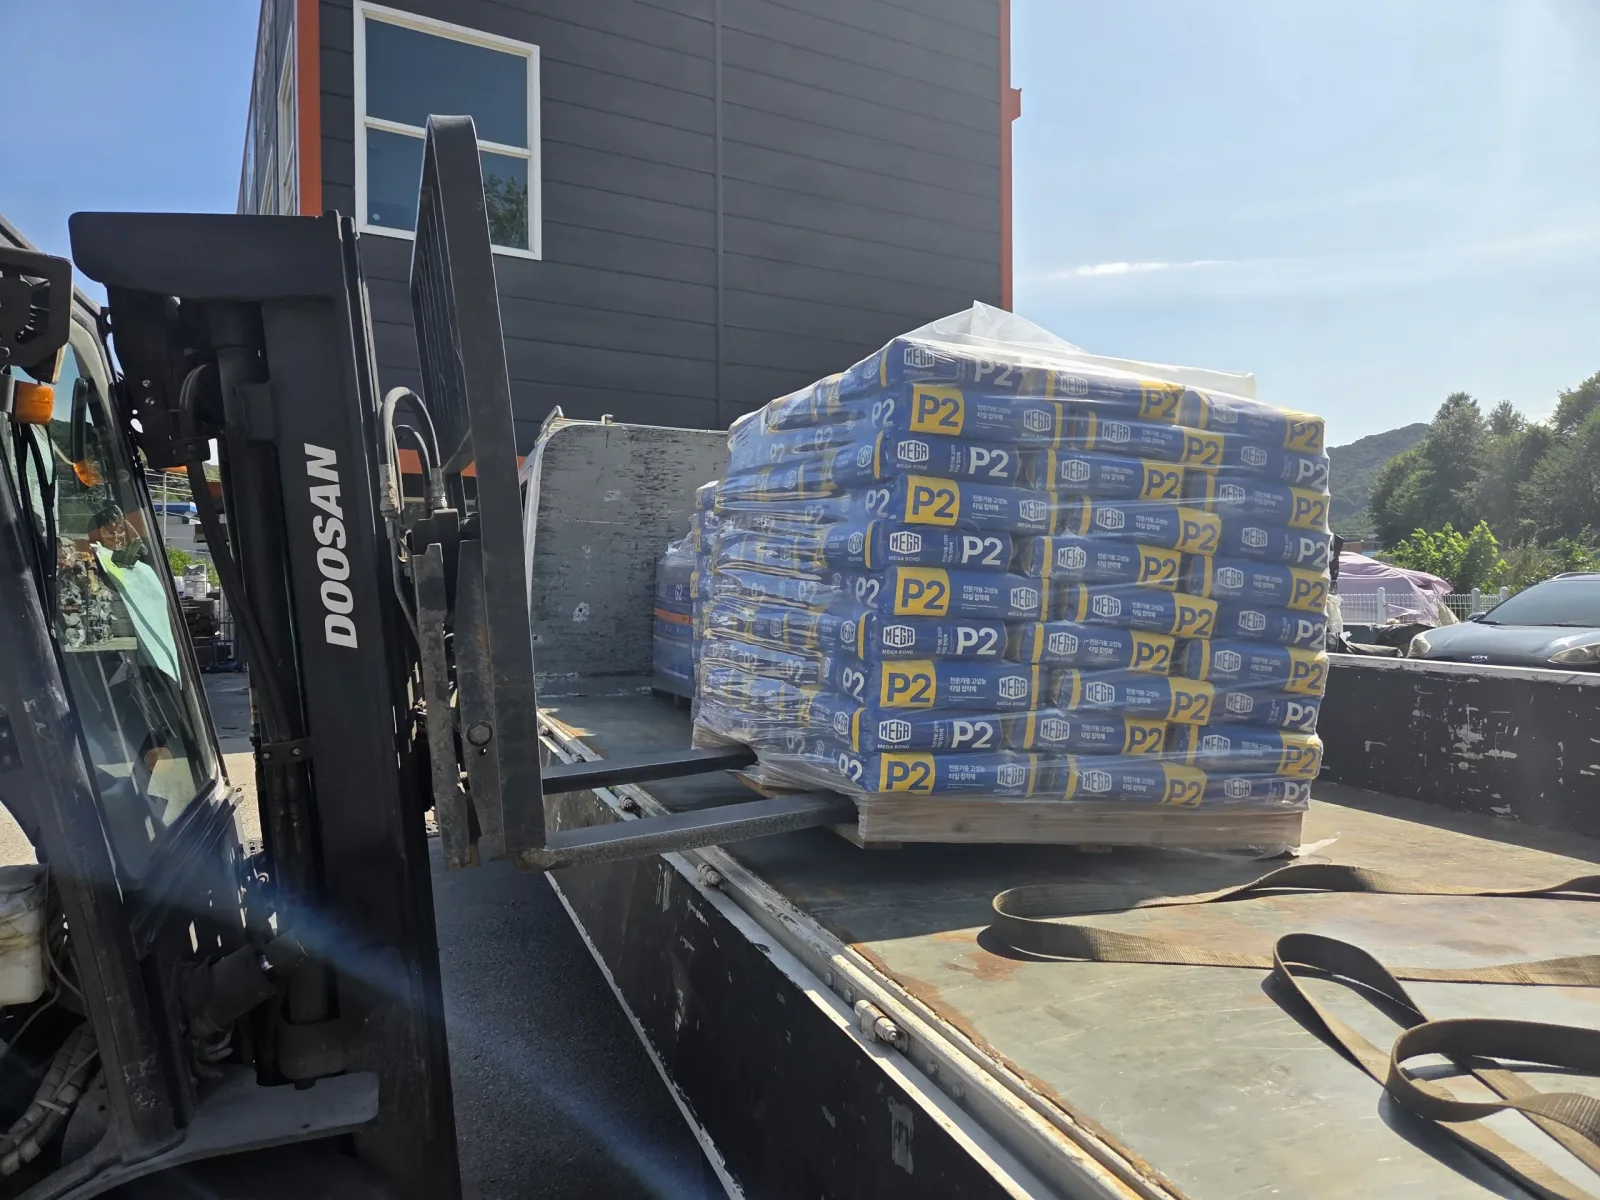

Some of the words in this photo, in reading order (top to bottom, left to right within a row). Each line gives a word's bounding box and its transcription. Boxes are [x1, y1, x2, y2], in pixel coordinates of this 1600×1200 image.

[905, 349, 934, 367] MEGA
[974, 359, 1013, 387] P2
[1061, 376, 1087, 394] MEGA
[917, 394, 960, 427] P2
[1144, 390, 1178, 418] P2
[1024, 410, 1050, 431] MEGA
[1103, 422, 1129, 442] MEGA
[1289, 421, 1319, 448] P2
[898, 441, 928, 462] MEGA
[968, 447, 1009, 477] P2
[1184, 436, 1218, 465] P2
[1063, 460, 1089, 481] MEGA
[1296, 459, 1328, 489] P2
[1145, 470, 1179, 499] P2
[1221, 485, 1244, 504] MEGA
[866, 489, 890, 517] P2
[912, 486, 955, 518] P2
[1020, 500, 1046, 520] MEGA
[1295, 497, 1324, 526] P2
[1097, 508, 1124, 529] MEGA
[304, 443, 358, 648] DOOSAN
[891, 532, 921, 553] MEGA
[1181, 521, 1217, 550] P2
[1243, 528, 1267, 547] MEGA
[962, 536, 1002, 565] P2
[1059, 547, 1085, 569] MEGA
[1298, 538, 1328, 567] P2
[1142, 556, 1176, 586] P2
[1218, 568, 1243, 587] MEGA
[856, 577, 880, 608] P2
[902, 578, 945, 610] P2
[1011, 587, 1037, 609] MEGA
[1294, 579, 1325, 607] P2
[1093, 596, 1120, 617] MEGA
[1177, 606, 1212, 635] P2
[1240, 611, 1265, 630] MEGA
[883, 625, 914, 647] MEGA
[956, 626, 998, 655] P2
[1049, 633, 1077, 655] MEGA
[1294, 620, 1325, 649] P2
[1134, 642, 1169, 671] P2
[1215, 651, 1240, 671] MEGA
[886, 672, 932, 704] P2
[1000, 676, 1027, 699] MEGA
[1291, 661, 1324, 690] P2
[1087, 682, 1114, 703] MEGA
[1172, 692, 1209, 720] P2
[1227, 693, 1252, 712] MEGA
[1041, 719, 1069, 740] MEGA
[1282, 702, 1316, 732] P2
[879, 720, 910, 742] MEGA
[951, 721, 993, 748] P2
[1127, 726, 1163, 754] P2
[1203, 736, 1229, 754] MEGA
[1282, 745, 1316, 773] P2
[886, 761, 930, 790] P2
[998, 764, 1025, 786] MEGA
[1083, 771, 1111, 792] MEGA
[1225, 779, 1250, 797] MEGA
[1166, 779, 1201, 805] P2
